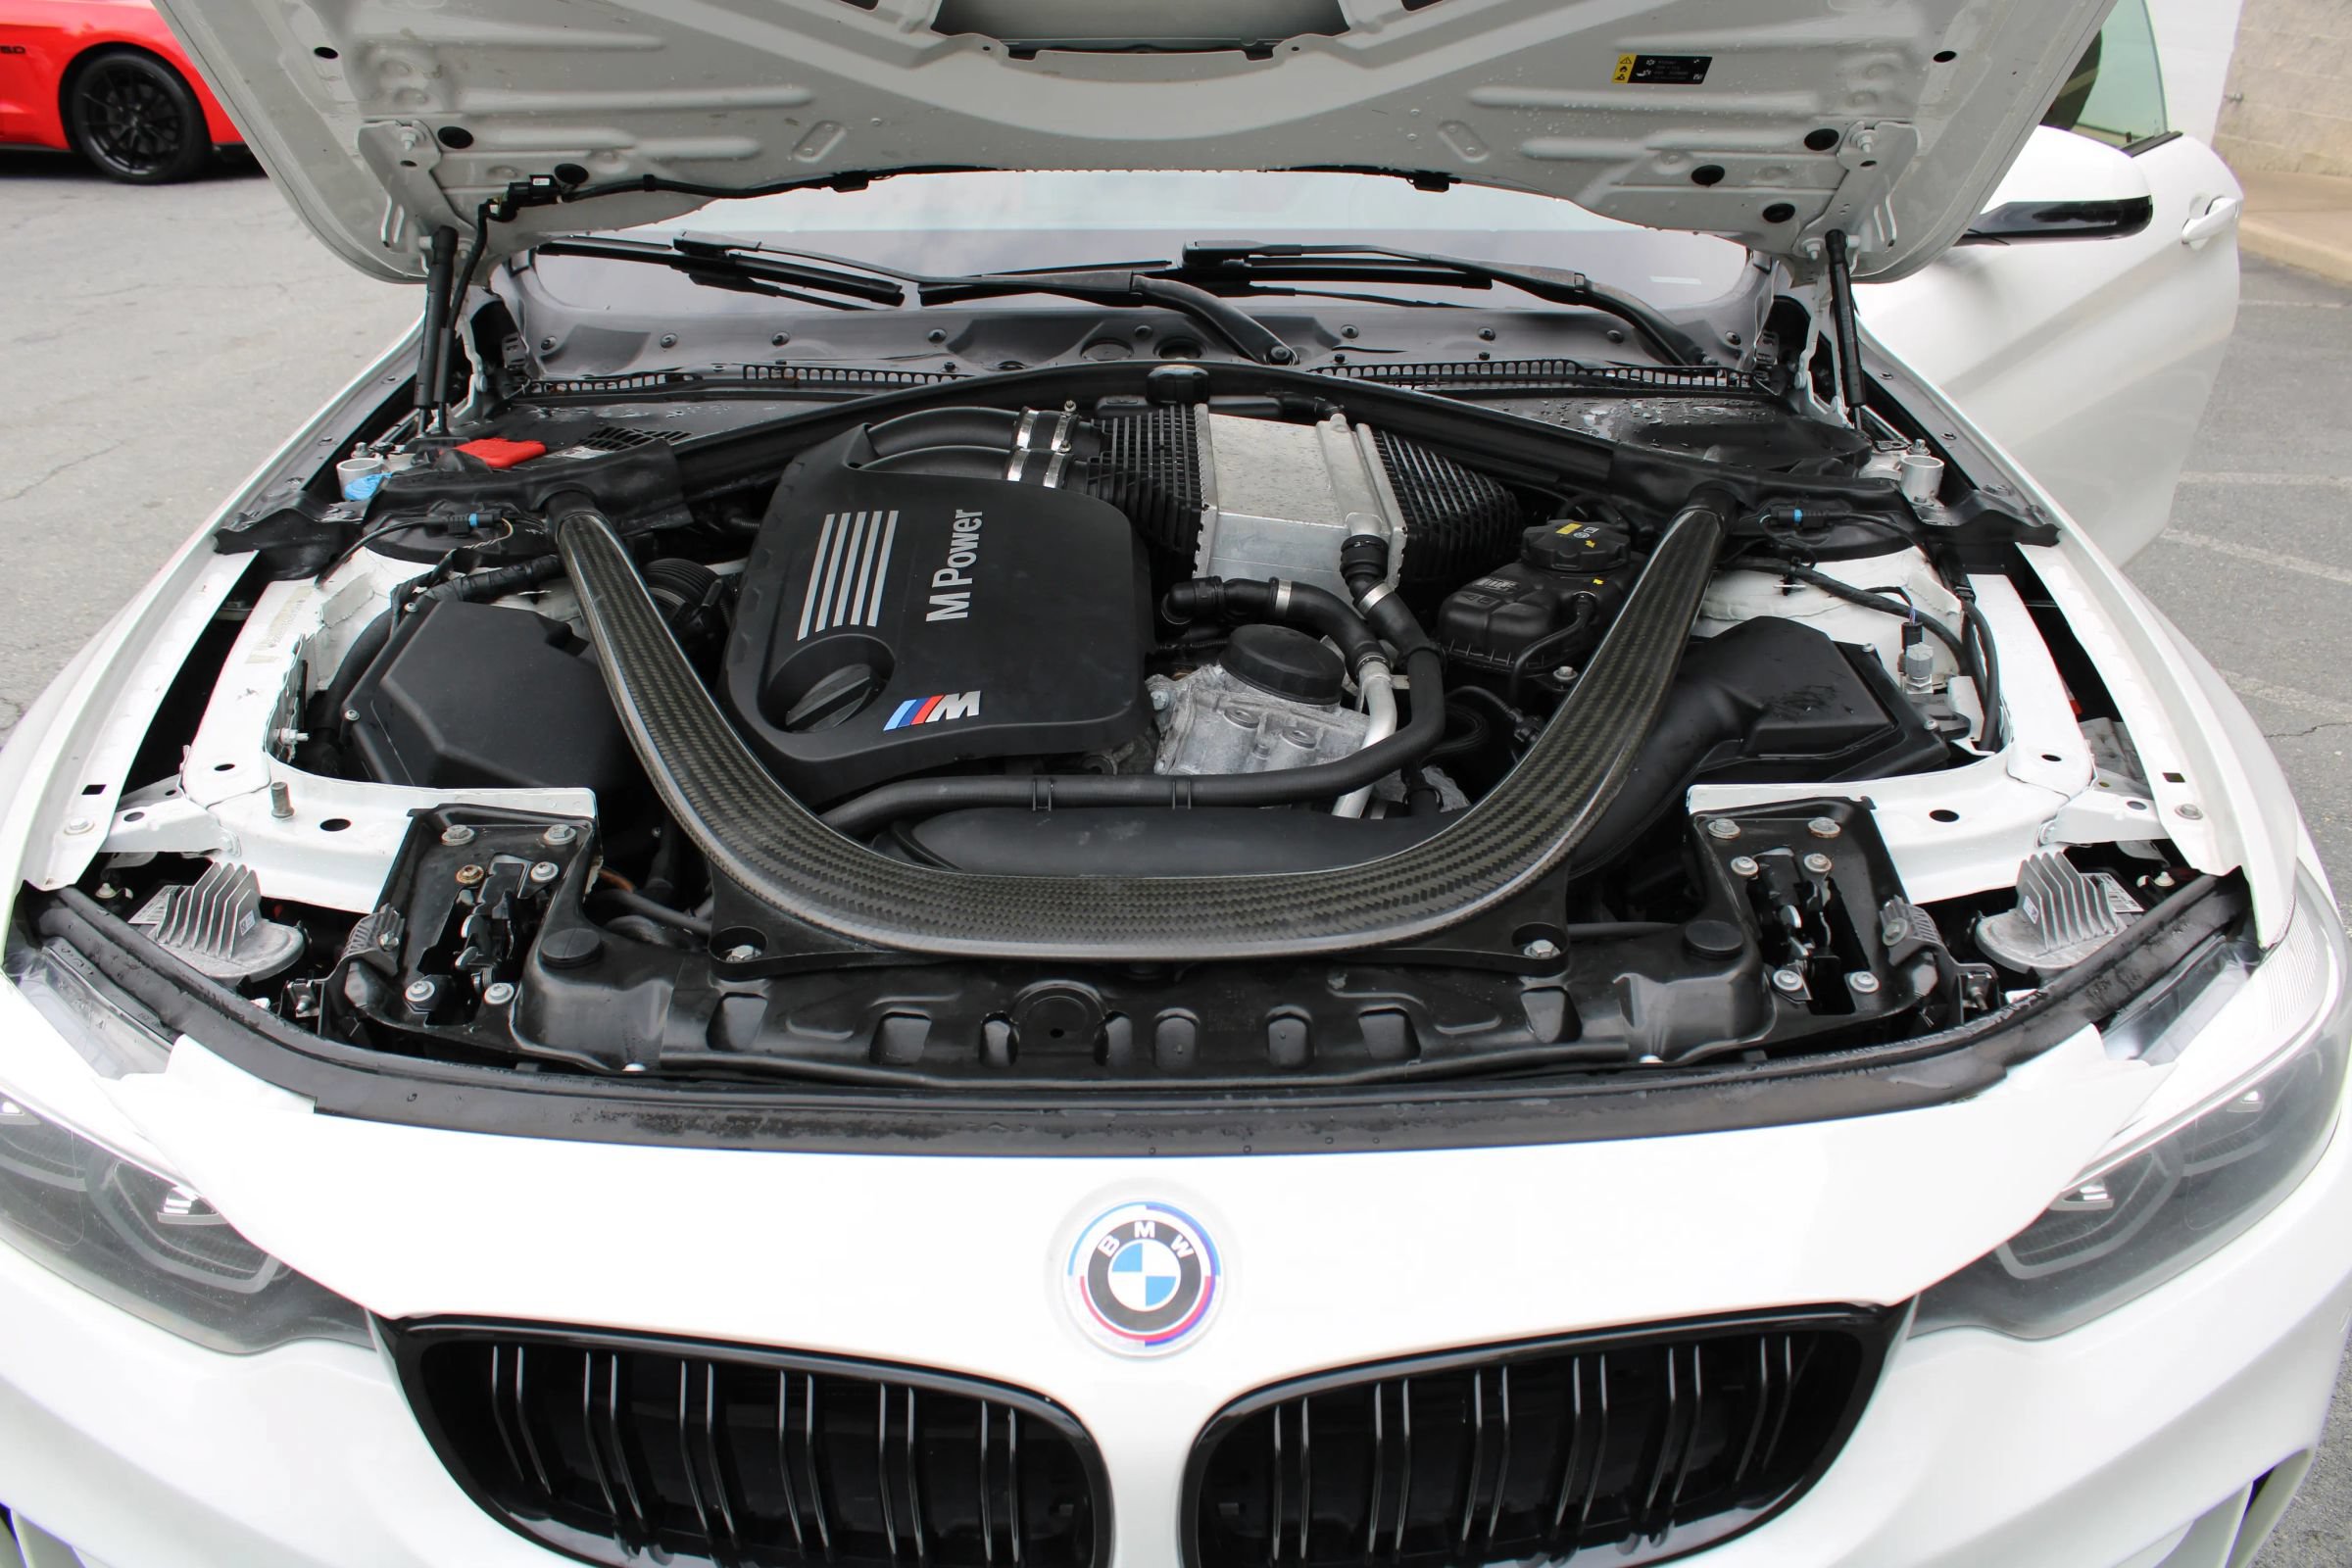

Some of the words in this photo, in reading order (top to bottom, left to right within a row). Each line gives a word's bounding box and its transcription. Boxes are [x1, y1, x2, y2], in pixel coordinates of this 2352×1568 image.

[932, 509, 983, 588] Power
[925, 591, 971, 622] M
[925, 690, 981, 722] M
[1097, 1220, 1196, 1258] BMW
